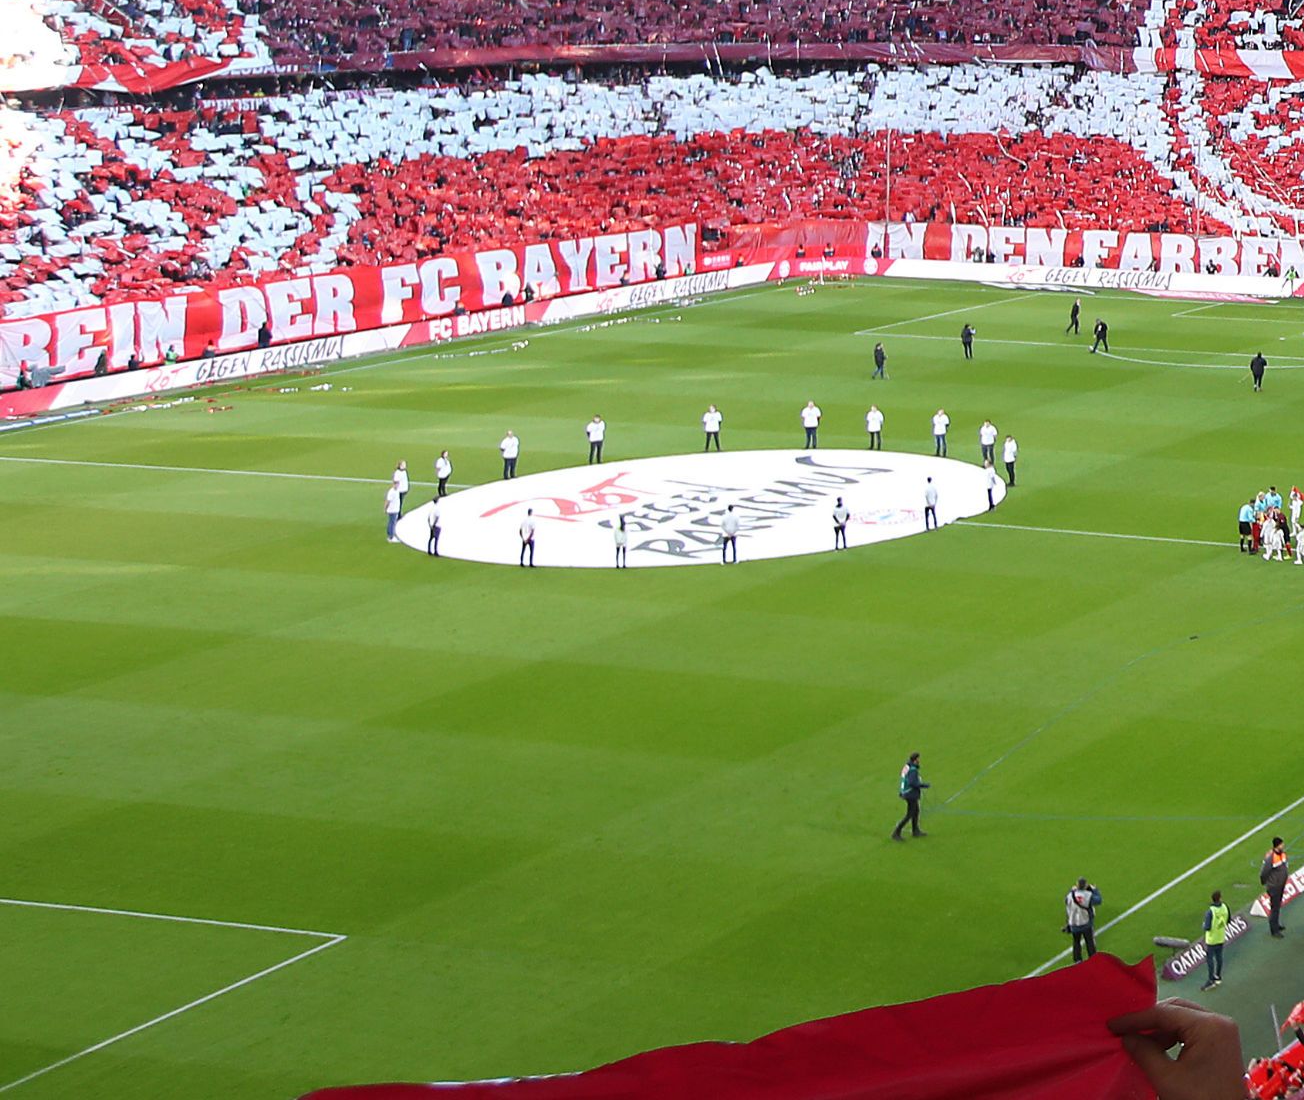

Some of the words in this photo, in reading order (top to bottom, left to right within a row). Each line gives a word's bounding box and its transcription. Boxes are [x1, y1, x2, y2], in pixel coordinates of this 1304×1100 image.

[866, 222, 927, 260] IN
[951, 223, 1068, 267] DEN
[218, 273, 357, 349] DER
[381, 257, 461, 325] FC
[475, 223, 698, 307] BAYERN
[629, 281, 667, 302] GEGEN
[674, 269, 730, 297] RASSISMUS
[1045, 268, 1091, 286] GEGEN
[1099, 270, 1174, 291] RASSISMUS
[429, 318, 452, 341] FC
[457, 305, 525, 336] BAYERN
[196, 355, 250, 382] GEGEN
[260, 335, 345, 369] RASSISMUS
[479, 471, 660, 523] ROT
[1171, 944, 1207, 976] QATAR
